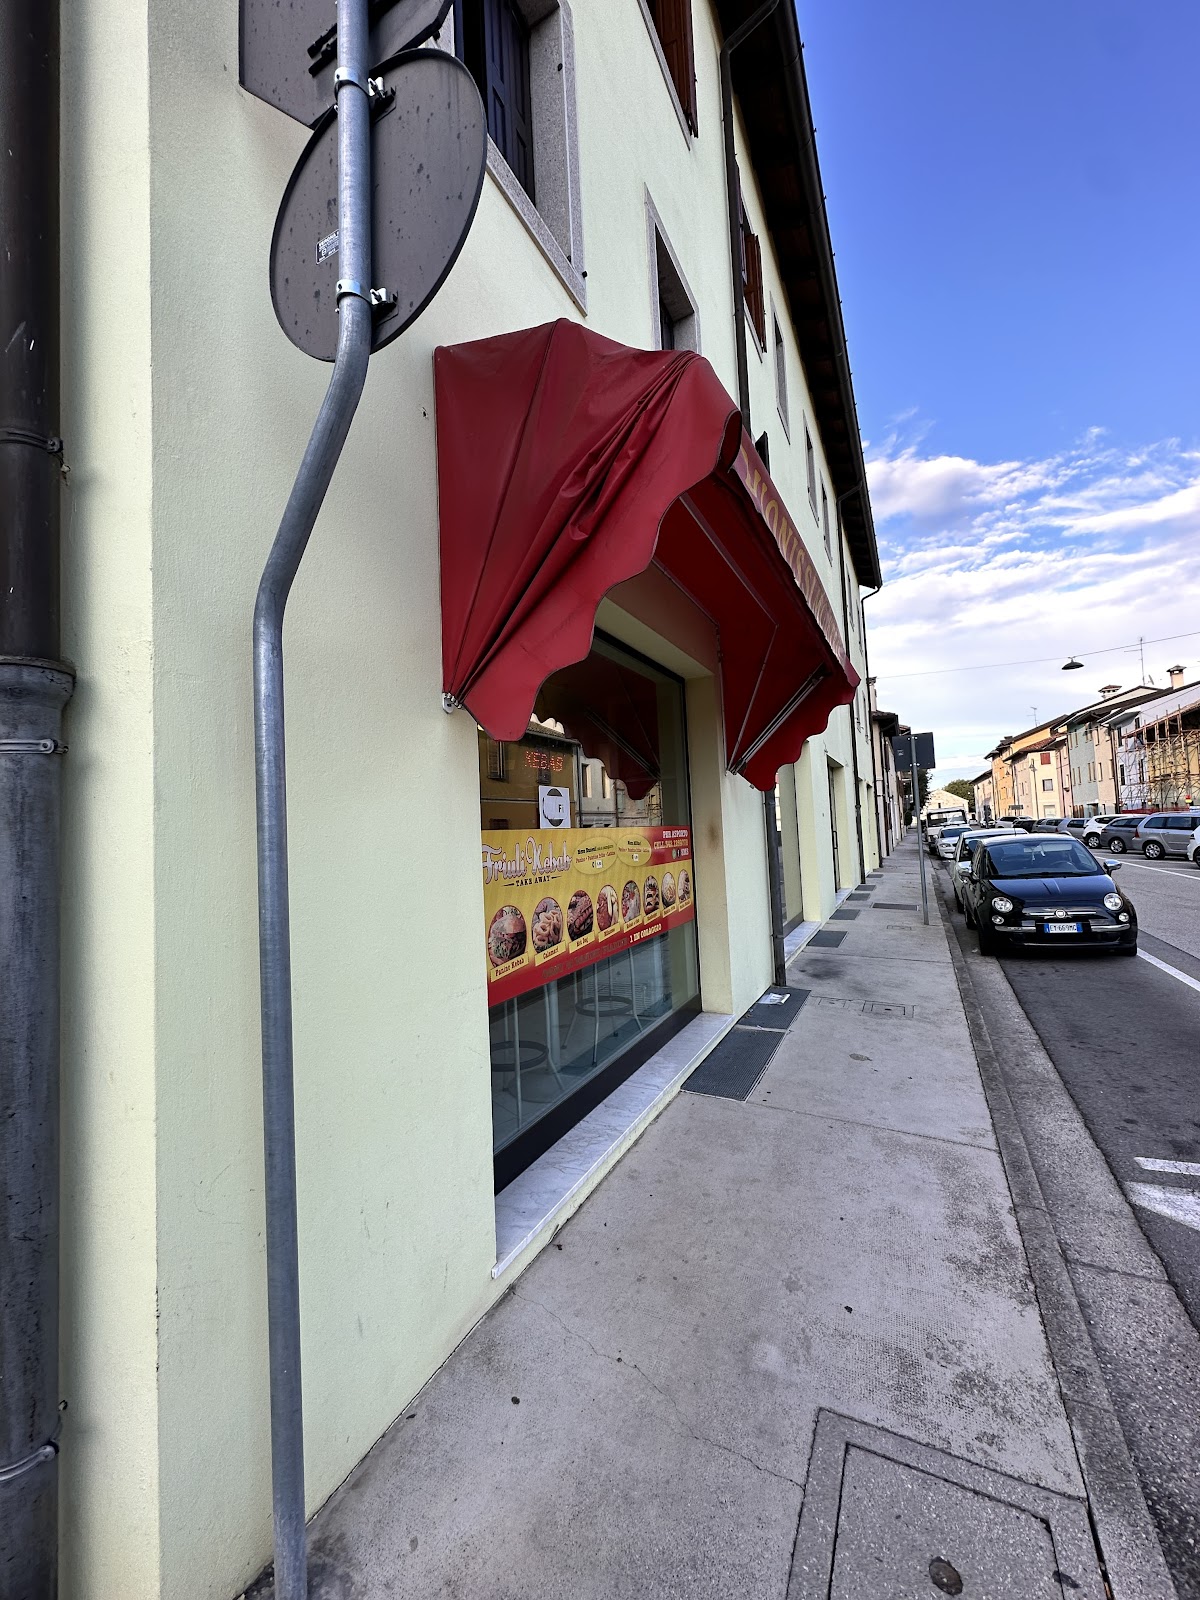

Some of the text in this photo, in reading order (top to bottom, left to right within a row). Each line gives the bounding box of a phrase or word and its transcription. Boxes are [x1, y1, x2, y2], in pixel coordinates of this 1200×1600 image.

[525, 751, 564, 771] KEBAB
[482, 836, 572, 885] Friuli Kebab
[516, 875, 550, 887] TAKE AWAY
[542, 947, 559, 960] Calamari
[495, 958, 524, 977] Panino Kebab
